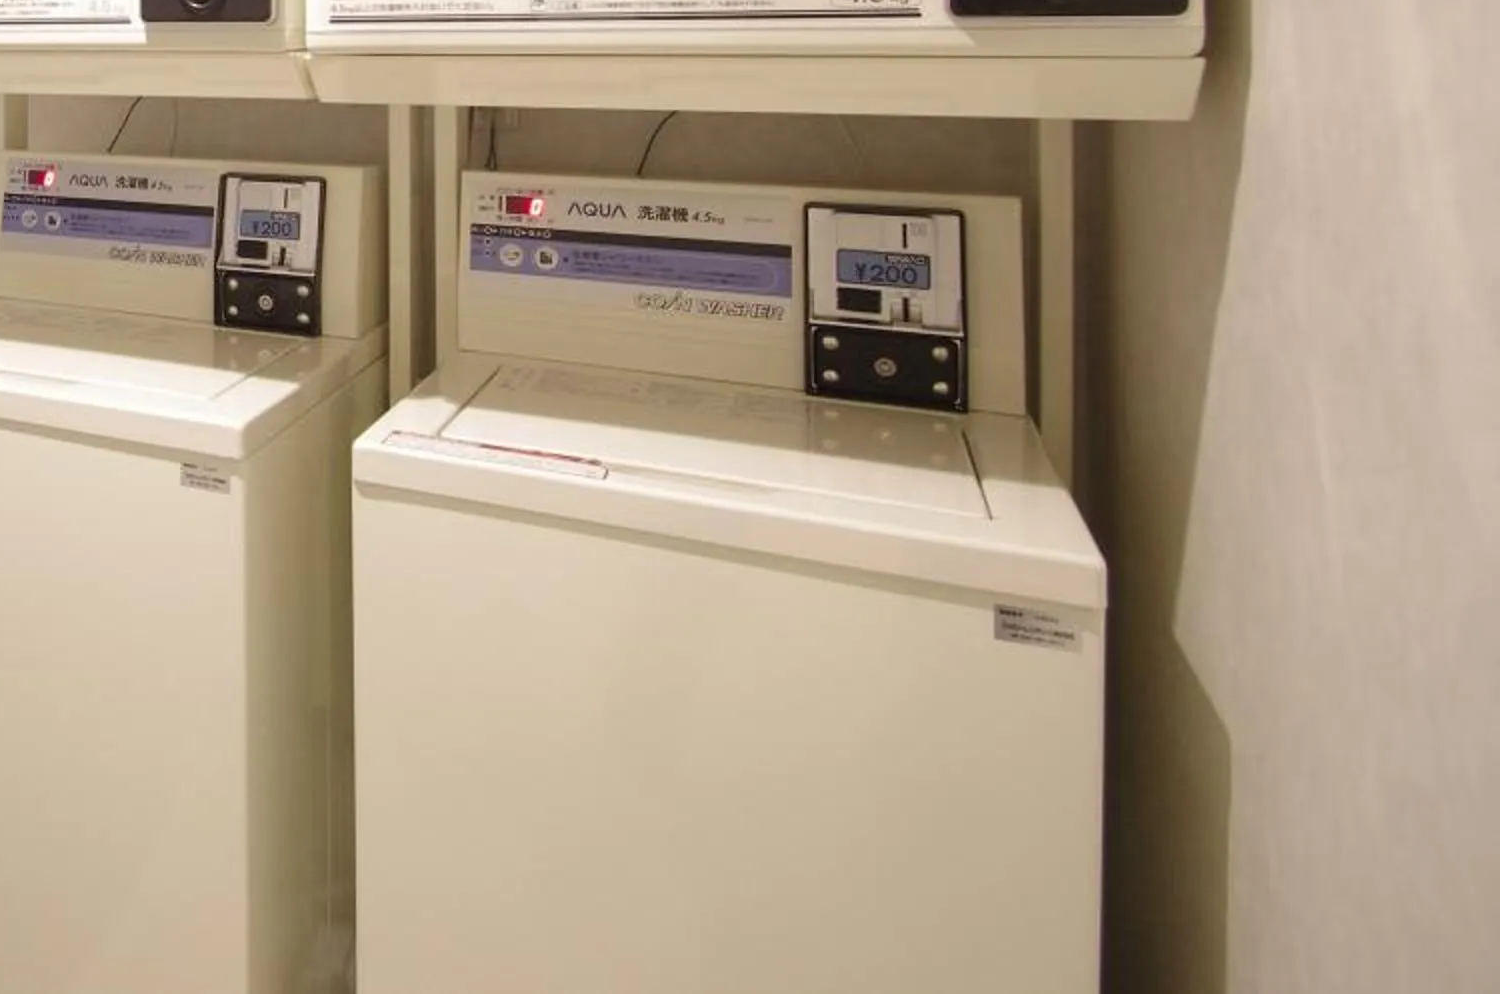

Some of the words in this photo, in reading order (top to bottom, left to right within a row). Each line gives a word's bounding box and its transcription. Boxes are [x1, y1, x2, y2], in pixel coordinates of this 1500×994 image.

[69, 174, 108, 187] AQUA
[567, 200, 627, 219] AQUA
[637, 206, 689, 223] 洗濯機
[855, 263, 918, 284] ¥200
